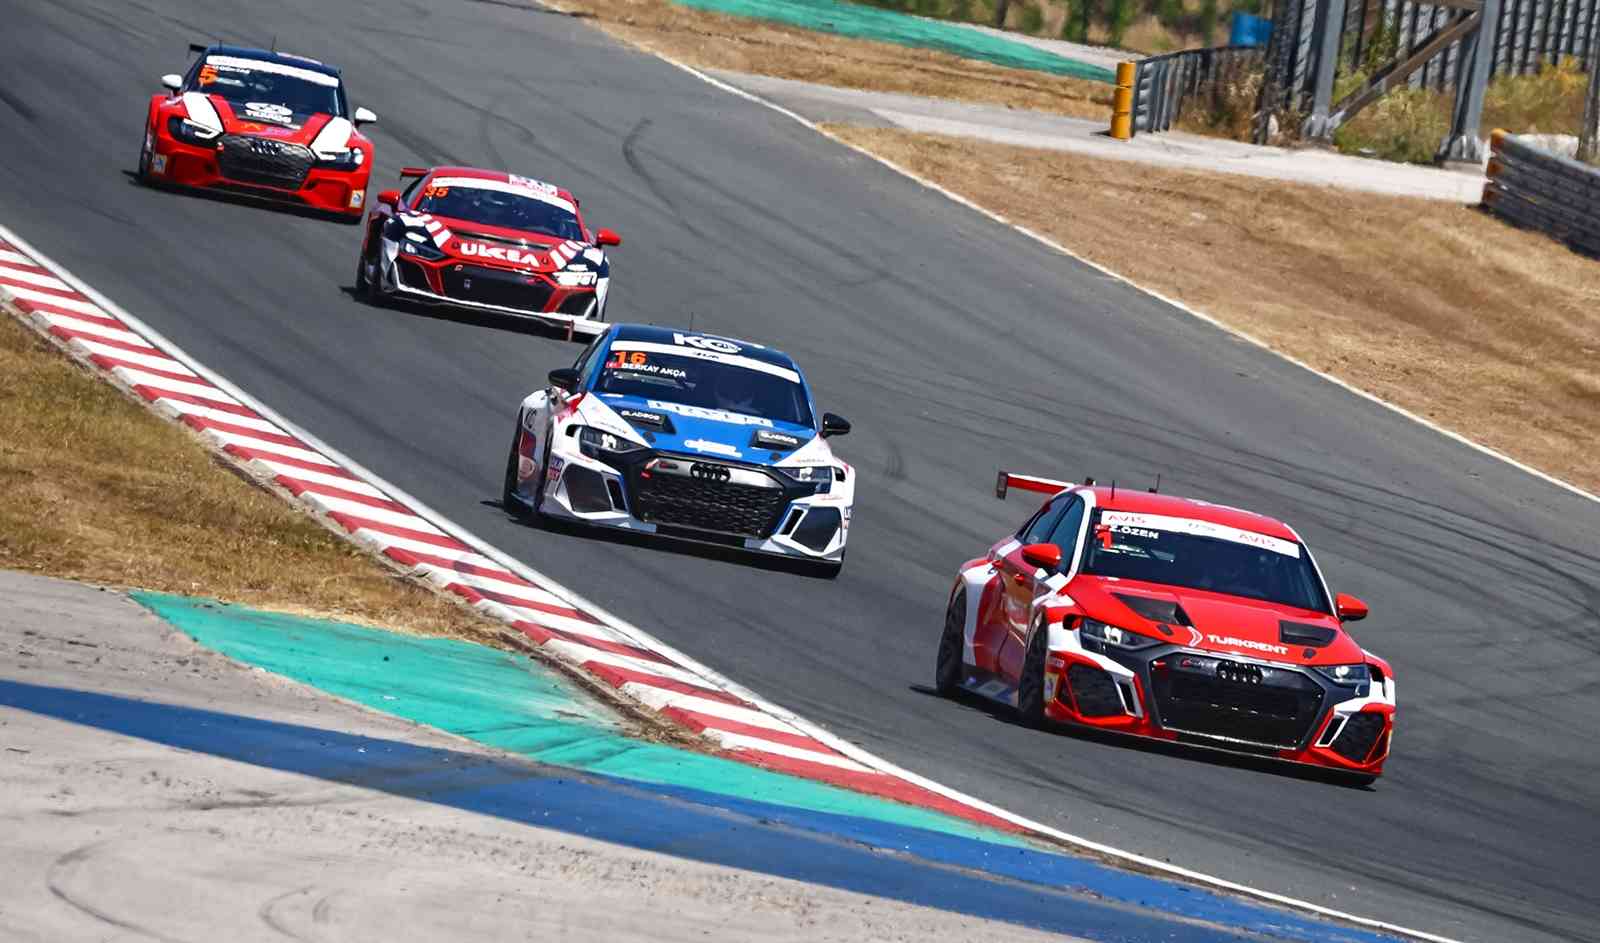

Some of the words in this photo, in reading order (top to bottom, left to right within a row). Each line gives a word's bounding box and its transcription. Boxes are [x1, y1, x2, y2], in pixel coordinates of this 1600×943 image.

[198, 66, 218, 85] 5
[615, 352, 646, 365] 16
[1108, 514, 1147, 524] AVIS
[1096, 530, 1112, 550] 1
[1240, 533, 1276, 547] AVIS
[1206, 633, 1289, 655] TURKRENT
